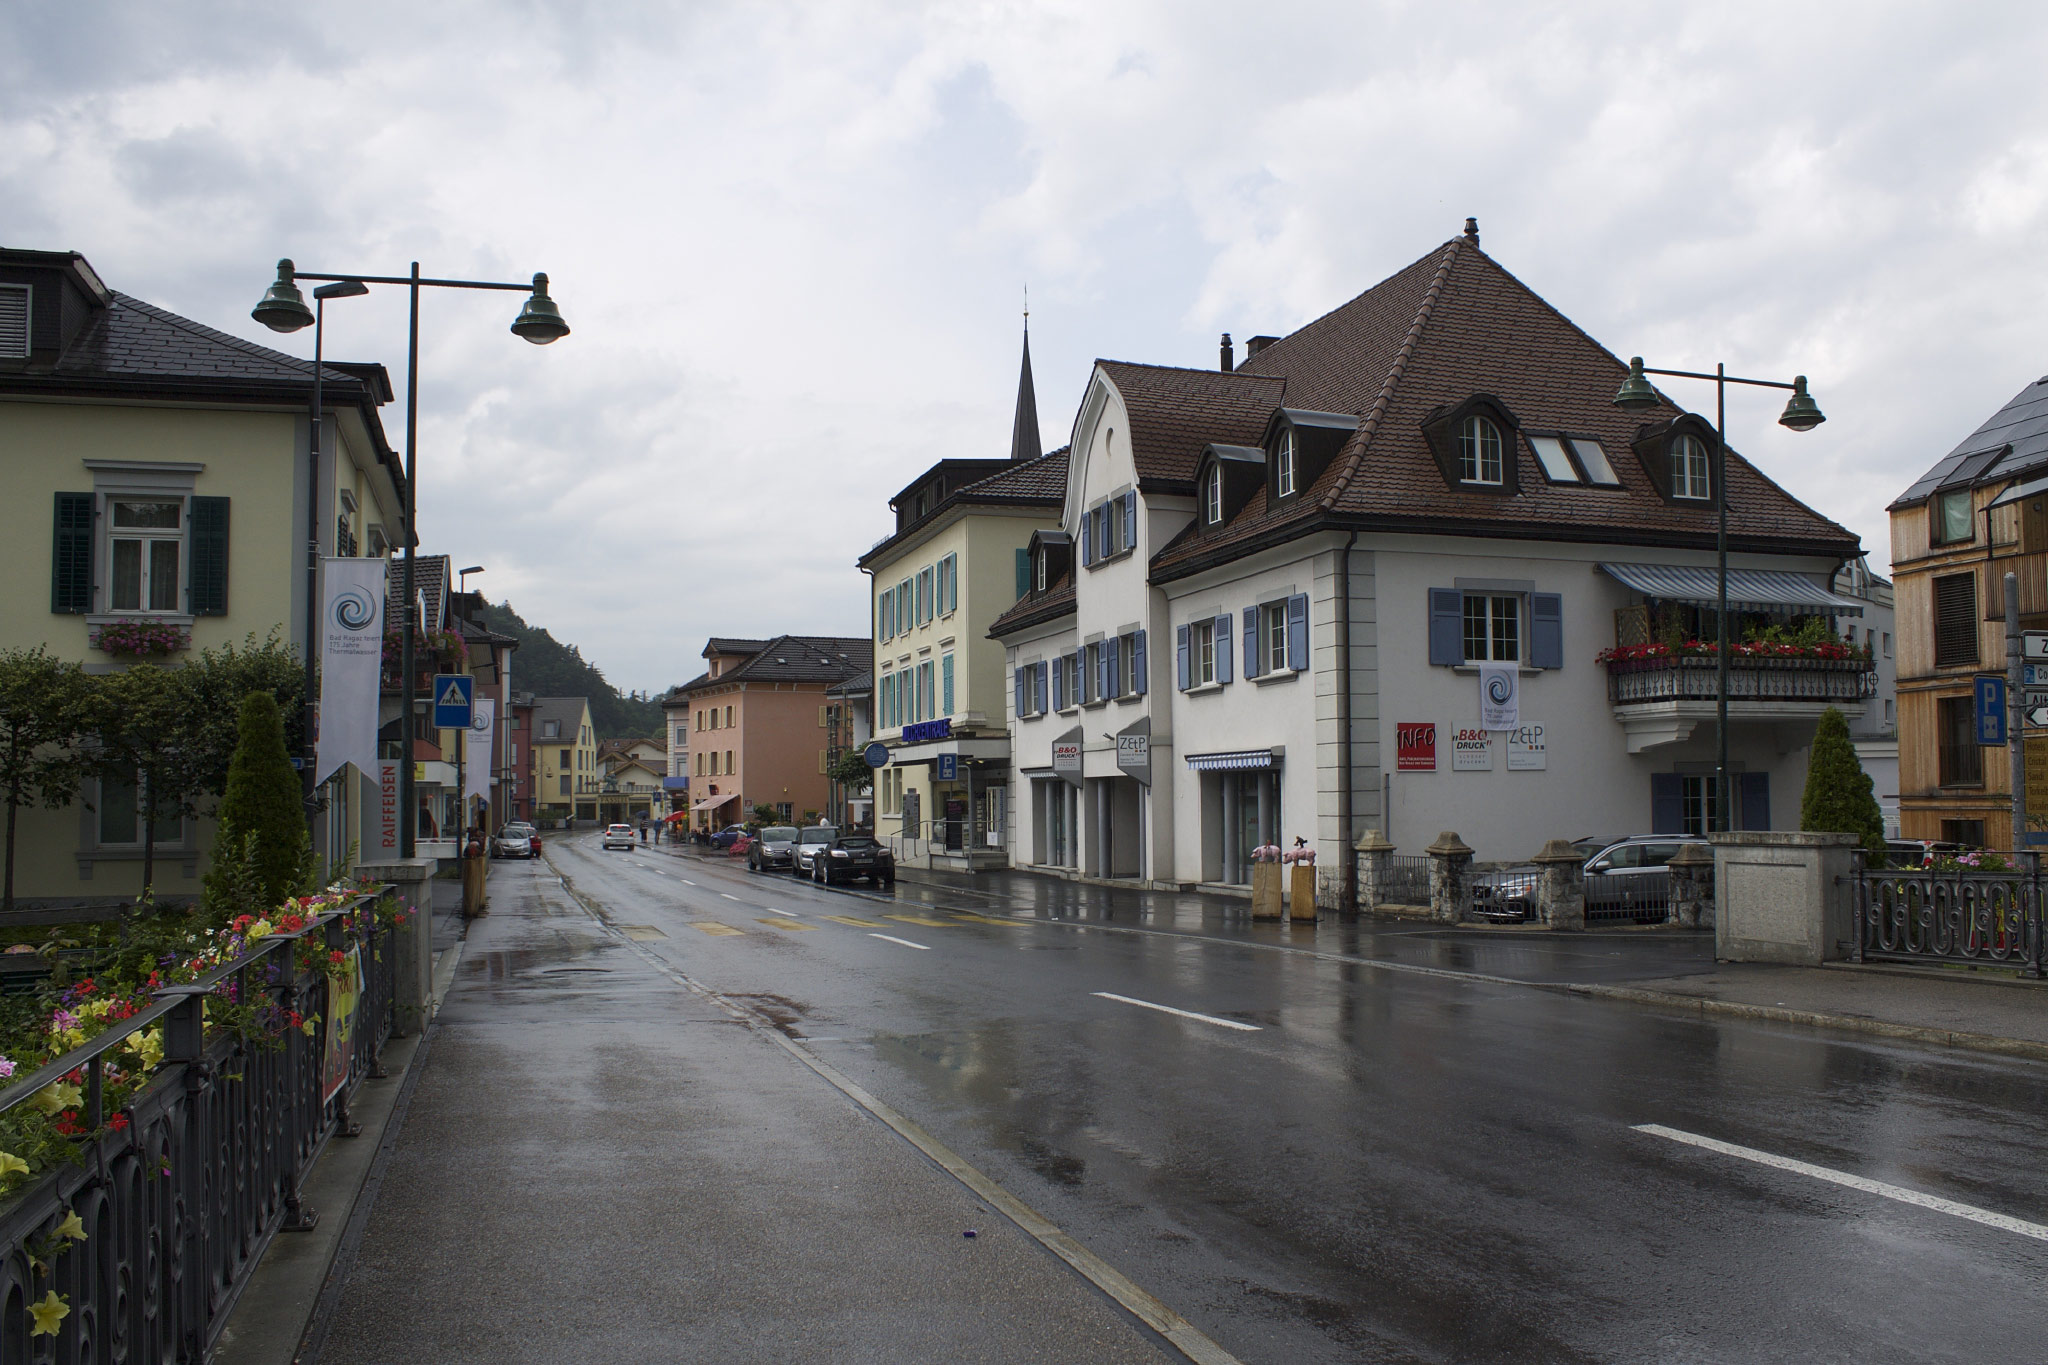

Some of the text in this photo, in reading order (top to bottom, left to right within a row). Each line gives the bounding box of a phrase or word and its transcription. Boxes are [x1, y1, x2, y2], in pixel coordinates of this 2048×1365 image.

[343, 634, 362, 643] Ragaz
[1983, 682, 1996, 714] P
[1397, 727, 1436, 750] INFO
[944, 756, 952, 768] P
[382, 766, 396, 848] RAIFFEISEN
